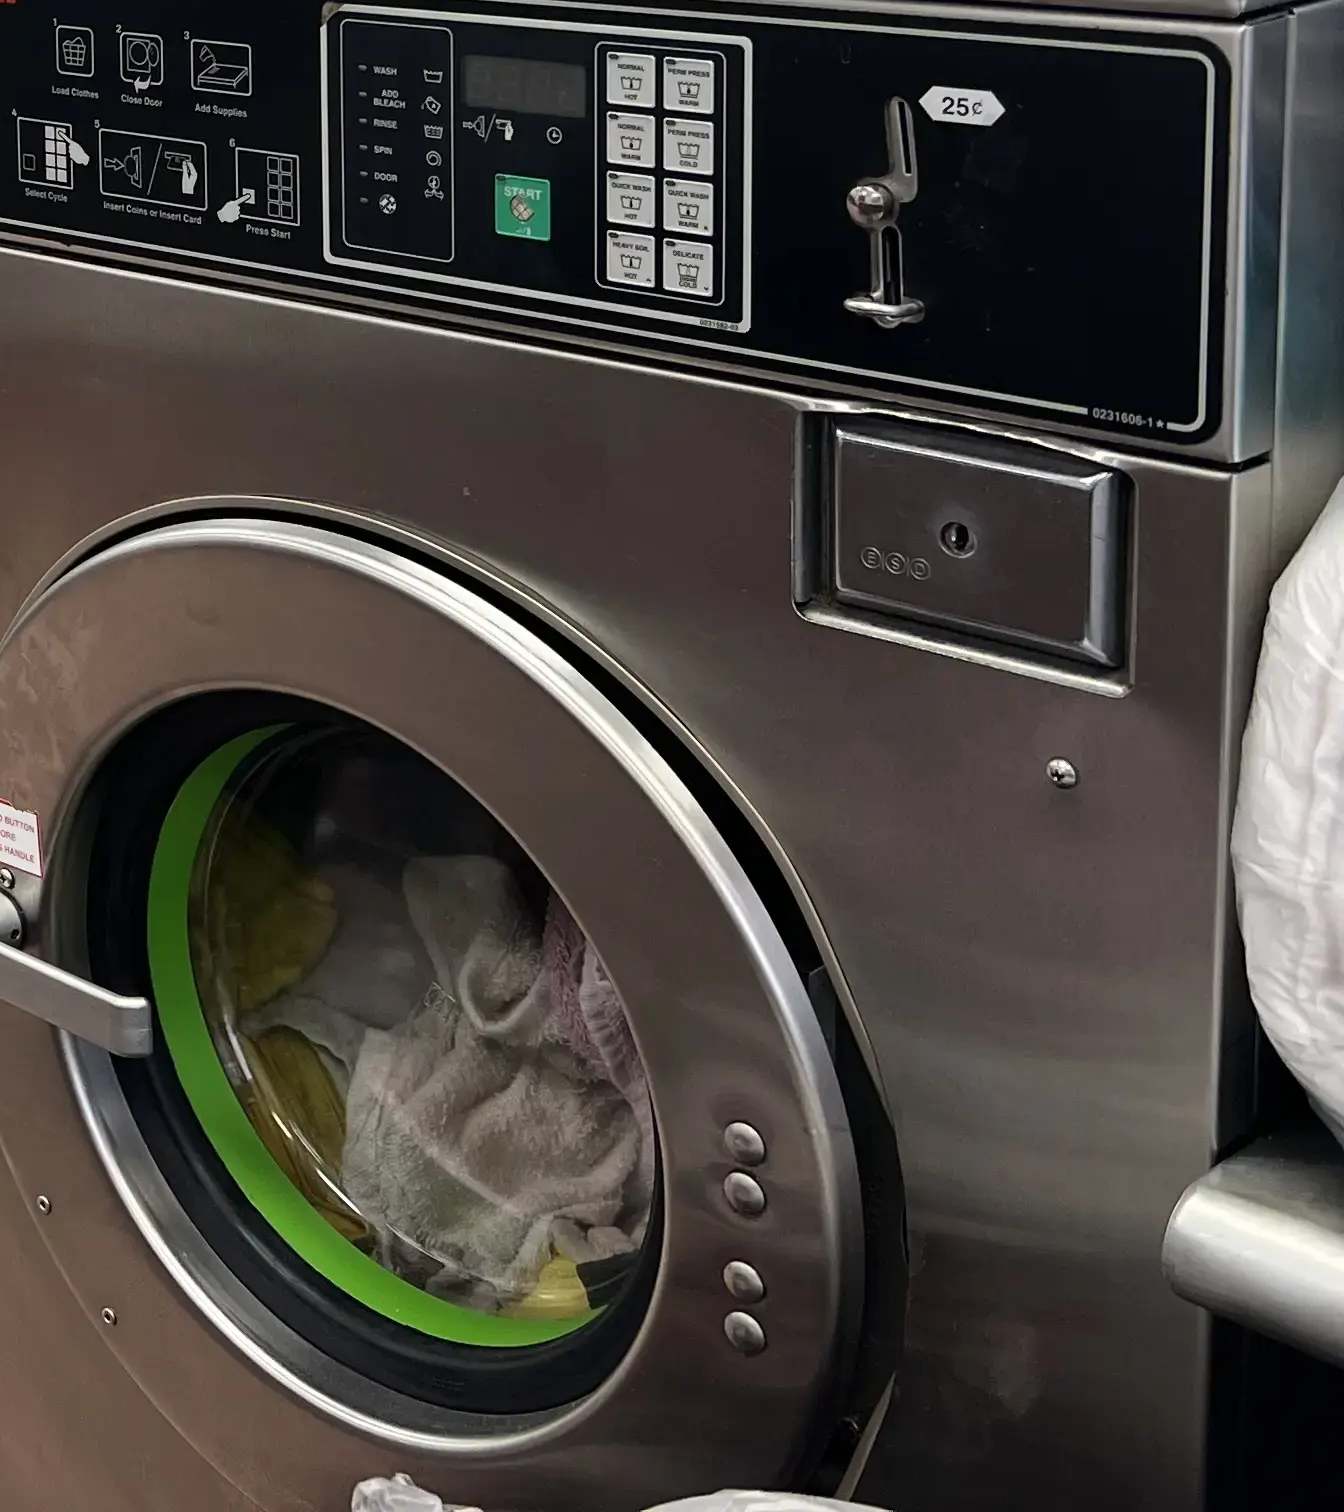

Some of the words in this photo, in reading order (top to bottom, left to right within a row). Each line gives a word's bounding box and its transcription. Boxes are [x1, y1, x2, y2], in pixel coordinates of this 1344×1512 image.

[53, 18, 57, 26] 1
[116, 24, 122, 33] 2
[184, 31, 190, 40] 3
[373, 66, 397, 76] WASH
[51, 85, 70, 96] Load
[71, 86, 99, 99] Clothes
[121, 94, 142, 106] Close
[144, 96, 163, 107] Door
[373, 98, 406, 109] BLEACH
[195, 103, 211, 114] Add
[212, 105, 248, 119] Supplies
[942, 97, 983, 116] 25¢
[12, 108, 17, 117] 4
[94, 120, 100, 128] 5
[373, 119, 398, 130] RINSE
[229, 139, 235, 147] 6
[374, 145, 393, 155] SPIN
[679, 160, 698, 168] COLD
[374, 172, 398, 182] DOOR
[24, 188, 47, 199] Select
[48, 190, 68, 203] Cycle
[504, 186, 542, 201] START
[103, 200, 124, 213] Insert
[126, 204, 148, 217] Coins
[150, 209, 158, 218] or
[159, 208, 182, 222] Insert
[183, 213, 202, 225] Card
[245, 224, 269, 237] Press
[270, 227, 291, 239] Start
[672, 250, 704, 260] DELICATE
[4, 816, 35, 834] BUTTON
[4, 845, 35, 863] HANDLE
